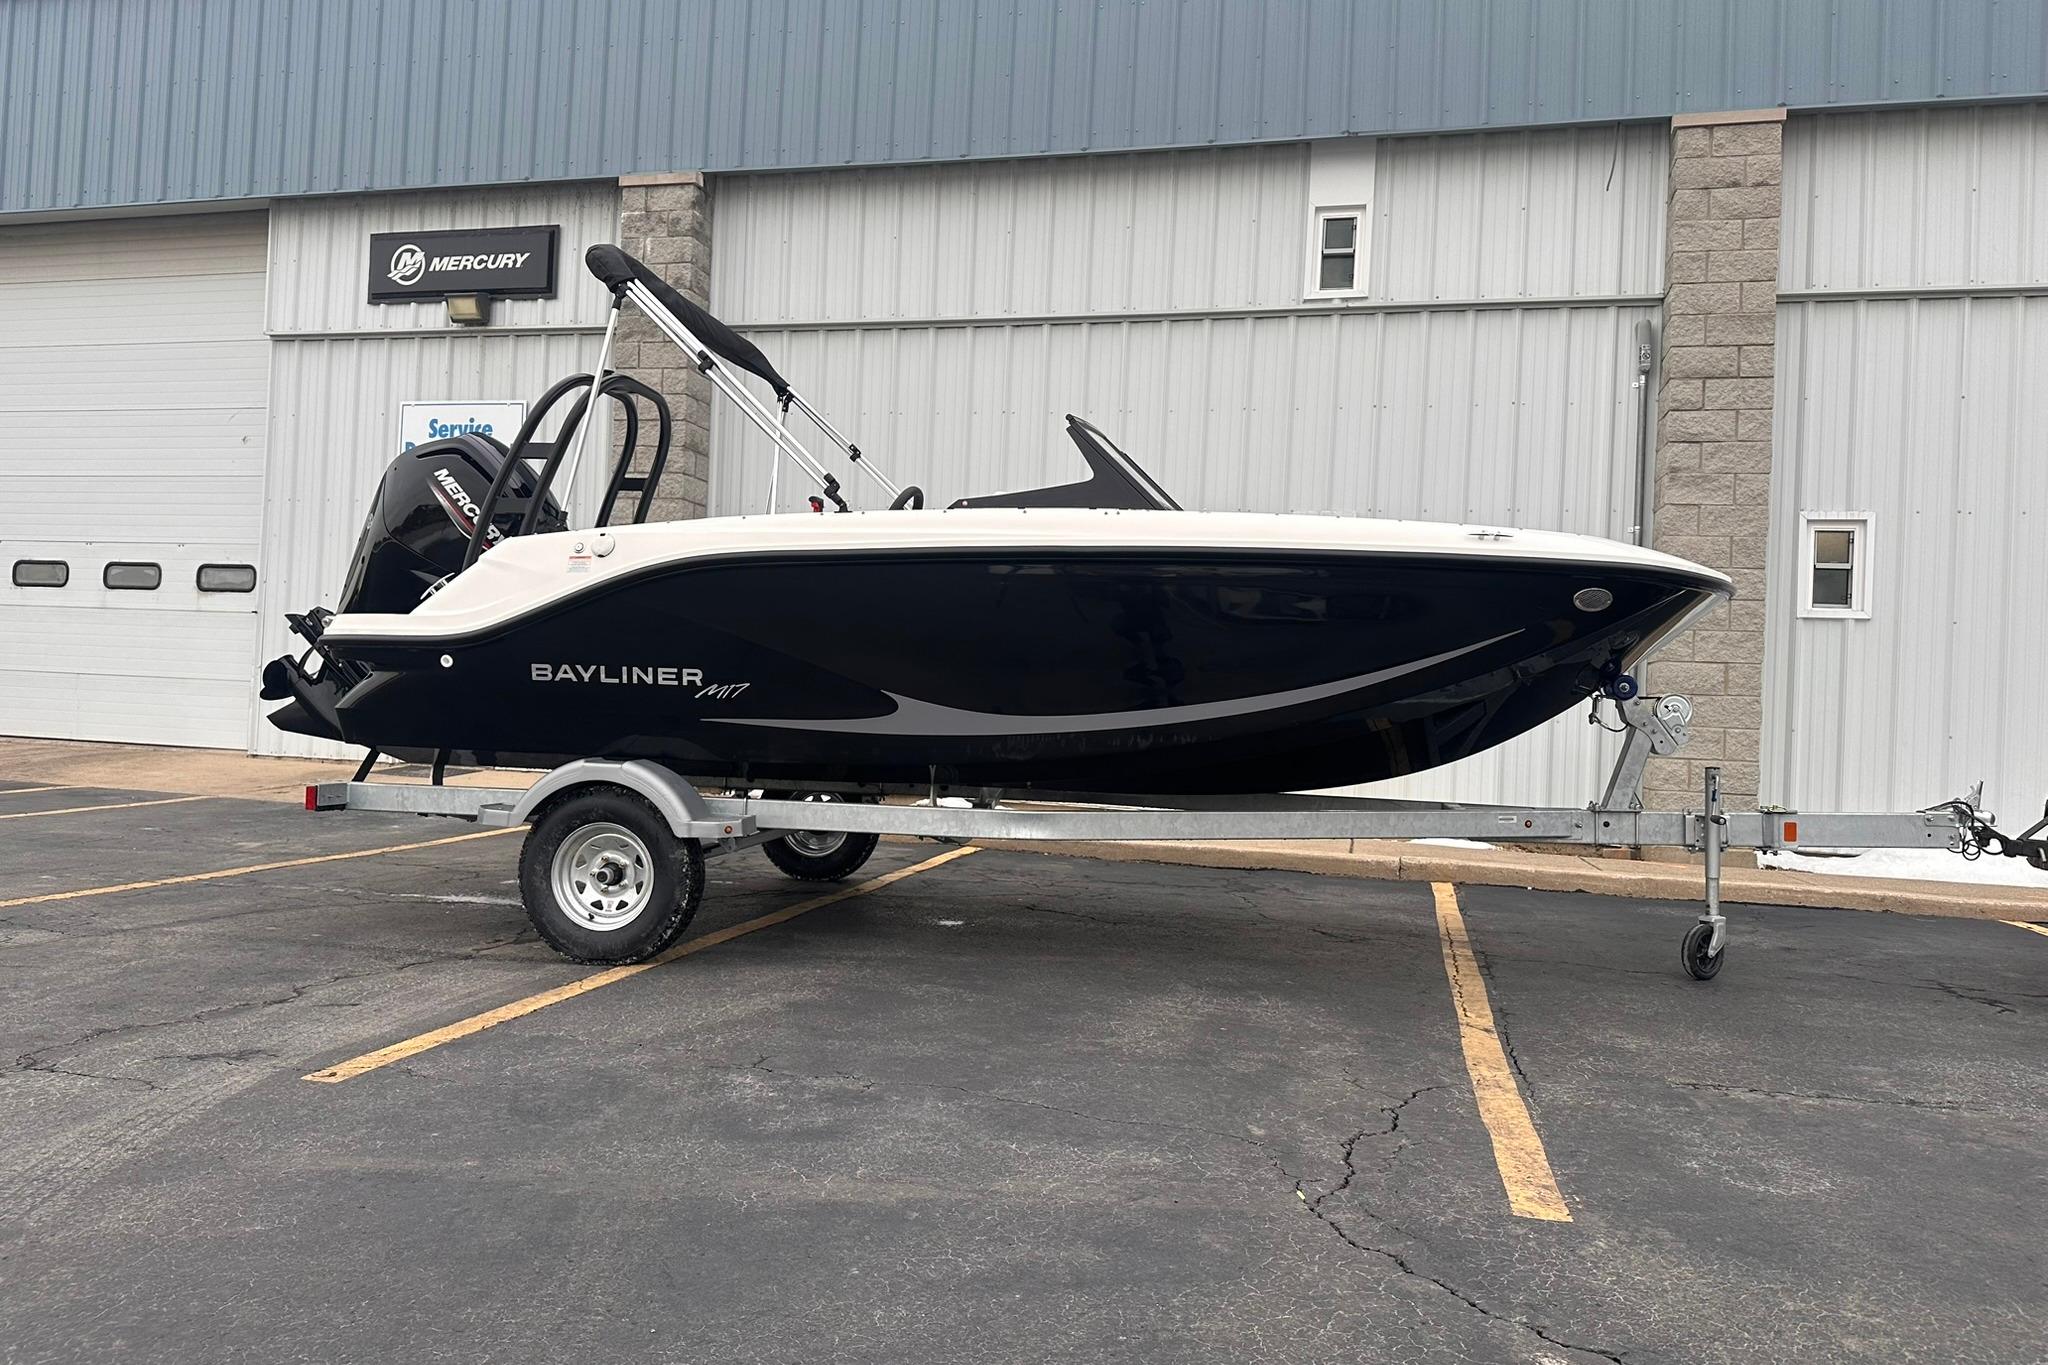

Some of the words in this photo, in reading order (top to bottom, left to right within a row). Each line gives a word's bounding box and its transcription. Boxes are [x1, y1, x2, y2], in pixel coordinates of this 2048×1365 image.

[429, 252, 531, 272] MERCURY
[428, 417, 493, 439] Service
[531, 663, 703, 686] BAYLINER
[694, 682, 750, 699] M17
